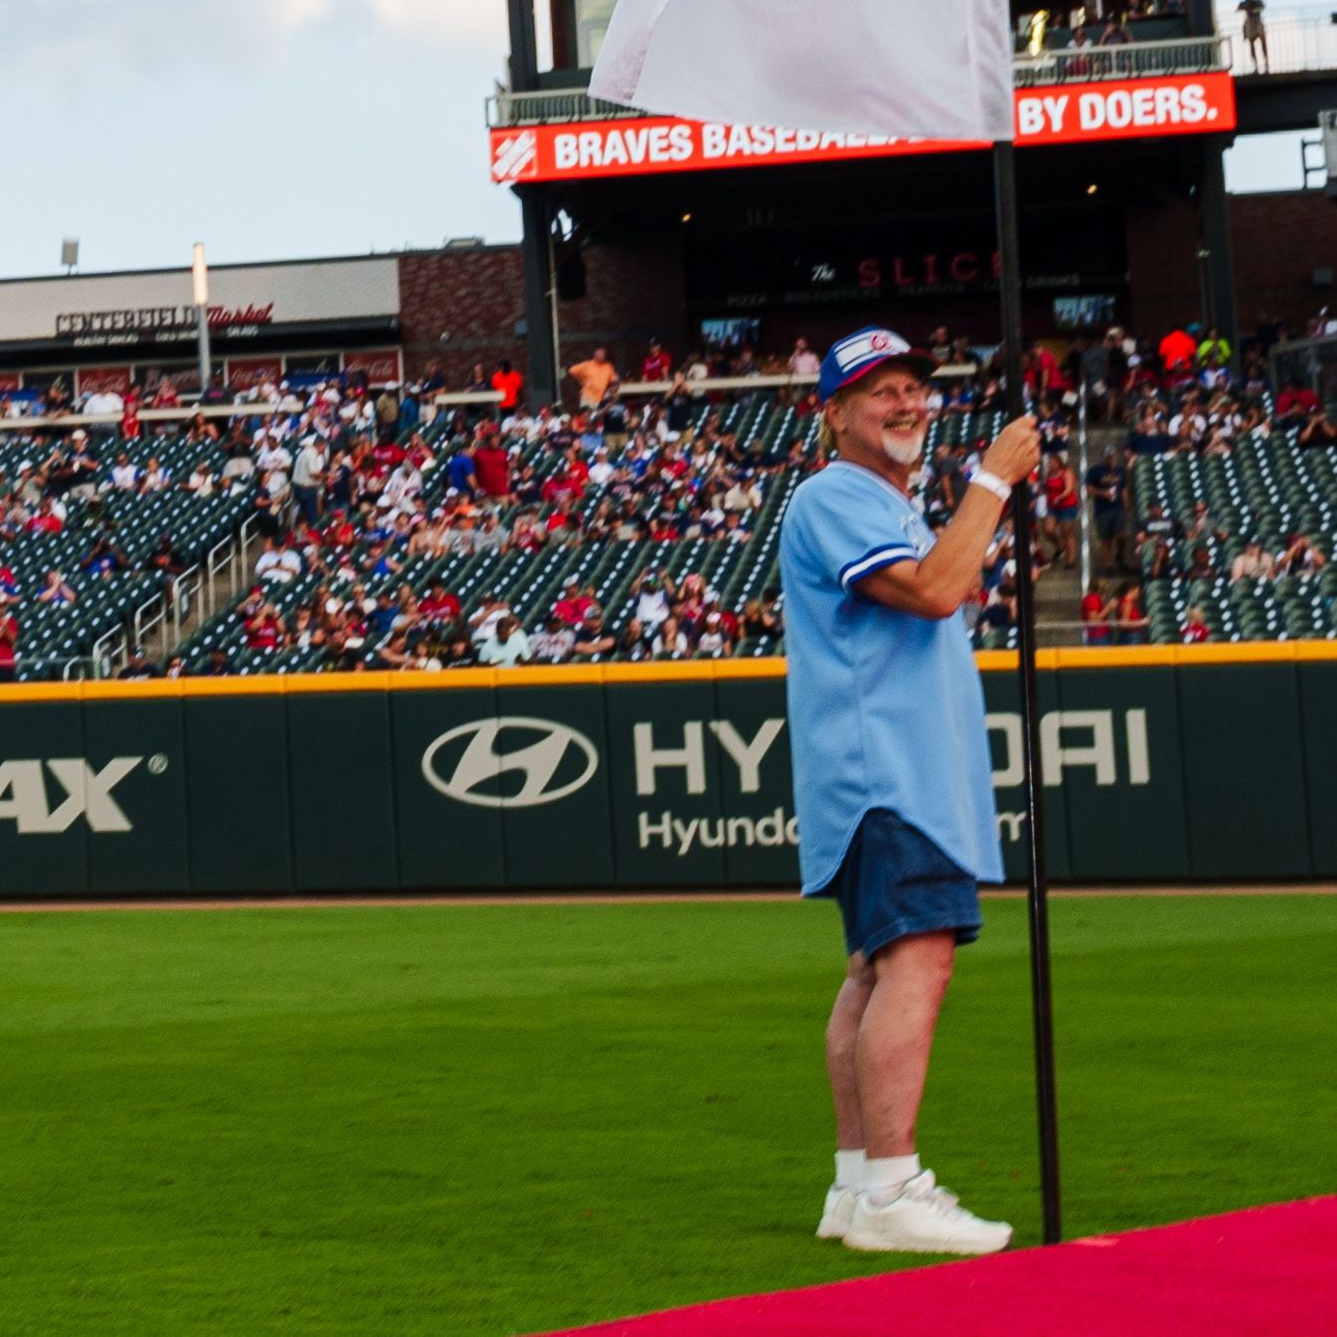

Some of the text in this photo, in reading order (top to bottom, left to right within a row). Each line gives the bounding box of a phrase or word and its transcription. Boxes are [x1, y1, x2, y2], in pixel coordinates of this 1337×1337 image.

[554, 125, 693, 170] BRAVES
[1018, 95, 1069, 135] BY
[1079, 83, 1219, 131] DOERS.
[633, 709, 1150, 797] HYDAI
